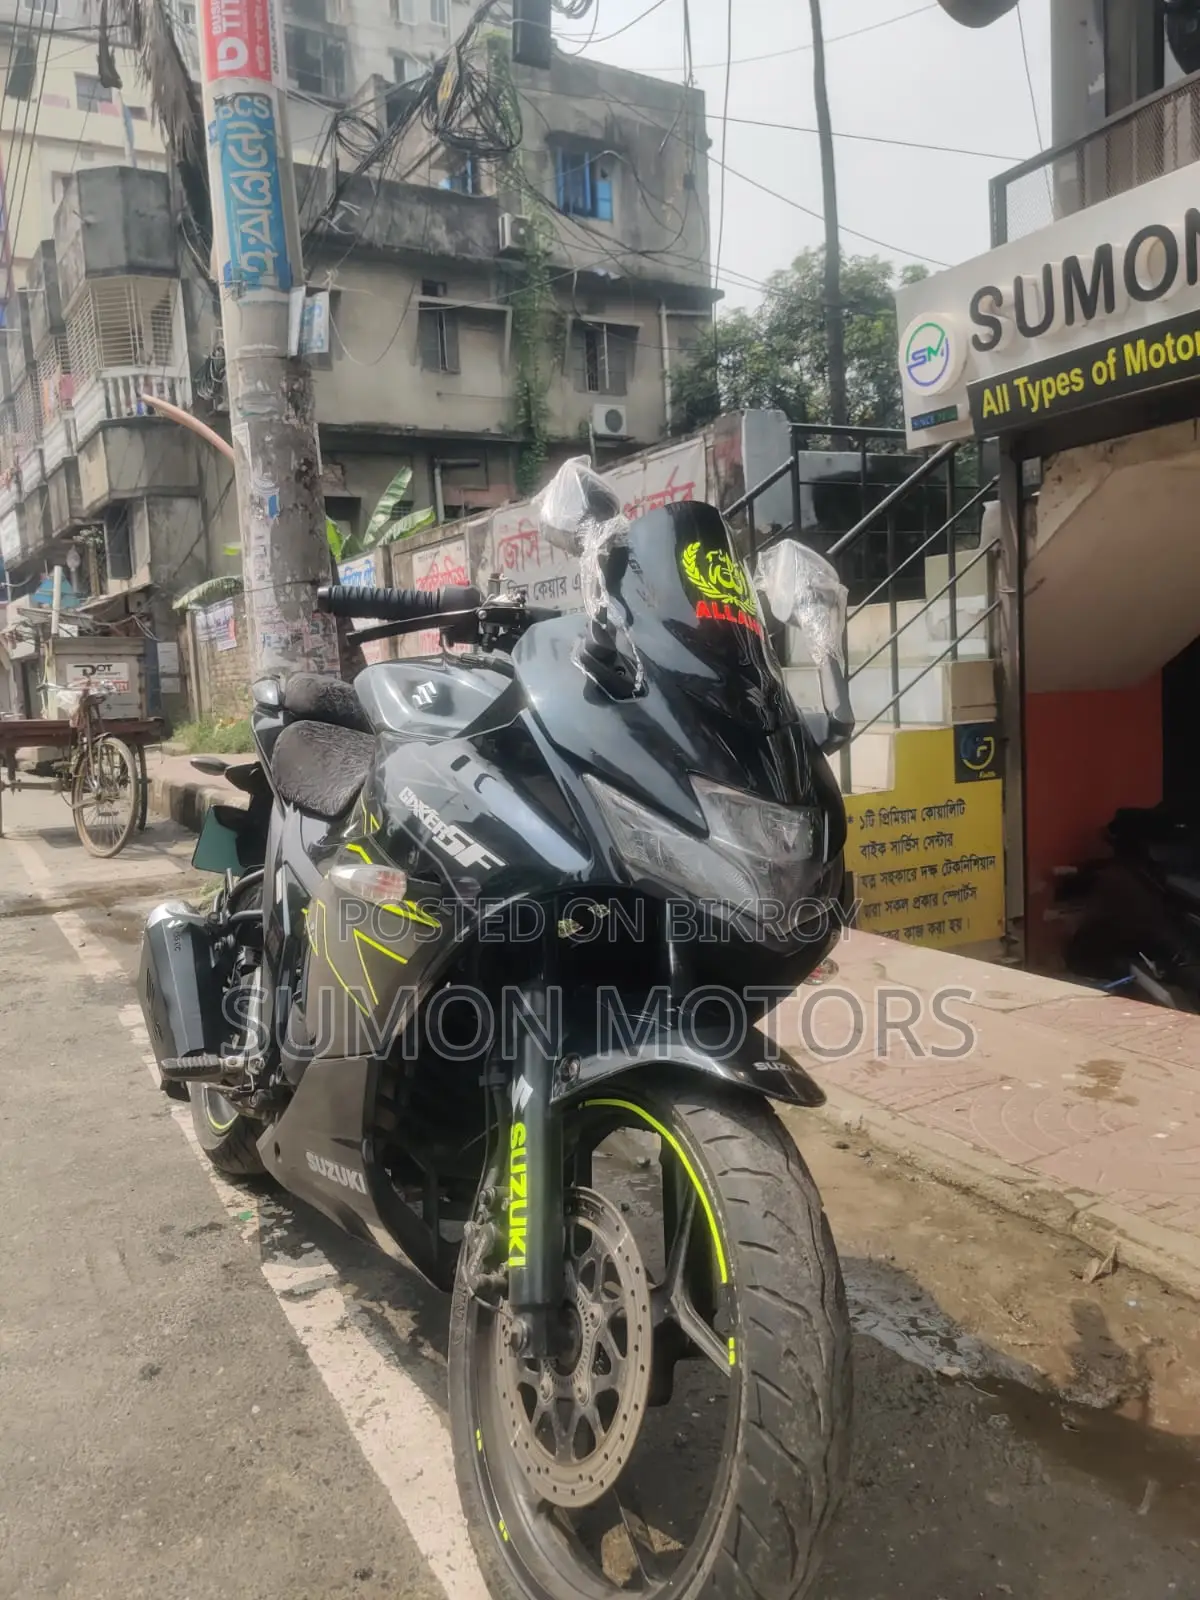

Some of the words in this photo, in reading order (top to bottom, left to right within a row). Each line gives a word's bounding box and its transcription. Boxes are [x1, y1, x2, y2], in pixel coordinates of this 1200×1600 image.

[982, 383, 1011, 419] All
[1013, 367, 1085, 413] Types
[1091, 348, 1118, 386] of
[859, 809, 876, 830] ১টি
[878, 806, 918, 828] প্রিমিয়াম
[921, 798, 967, 822] কোয়ালিটি
[859, 841, 887, 860] বাইক
[890, 834, 920, 857] সার্ভিস
[923, 831, 954, 850] সেন্টার
[942, 854, 997, 877] টেকনিশিয়ান
[884, 898, 910, 915] সকল
[912, 892, 939, 910] প্রকার
[305, 1151, 367, 1195] SUZUKI
[508, 1121, 528, 1268] SUZUKI
